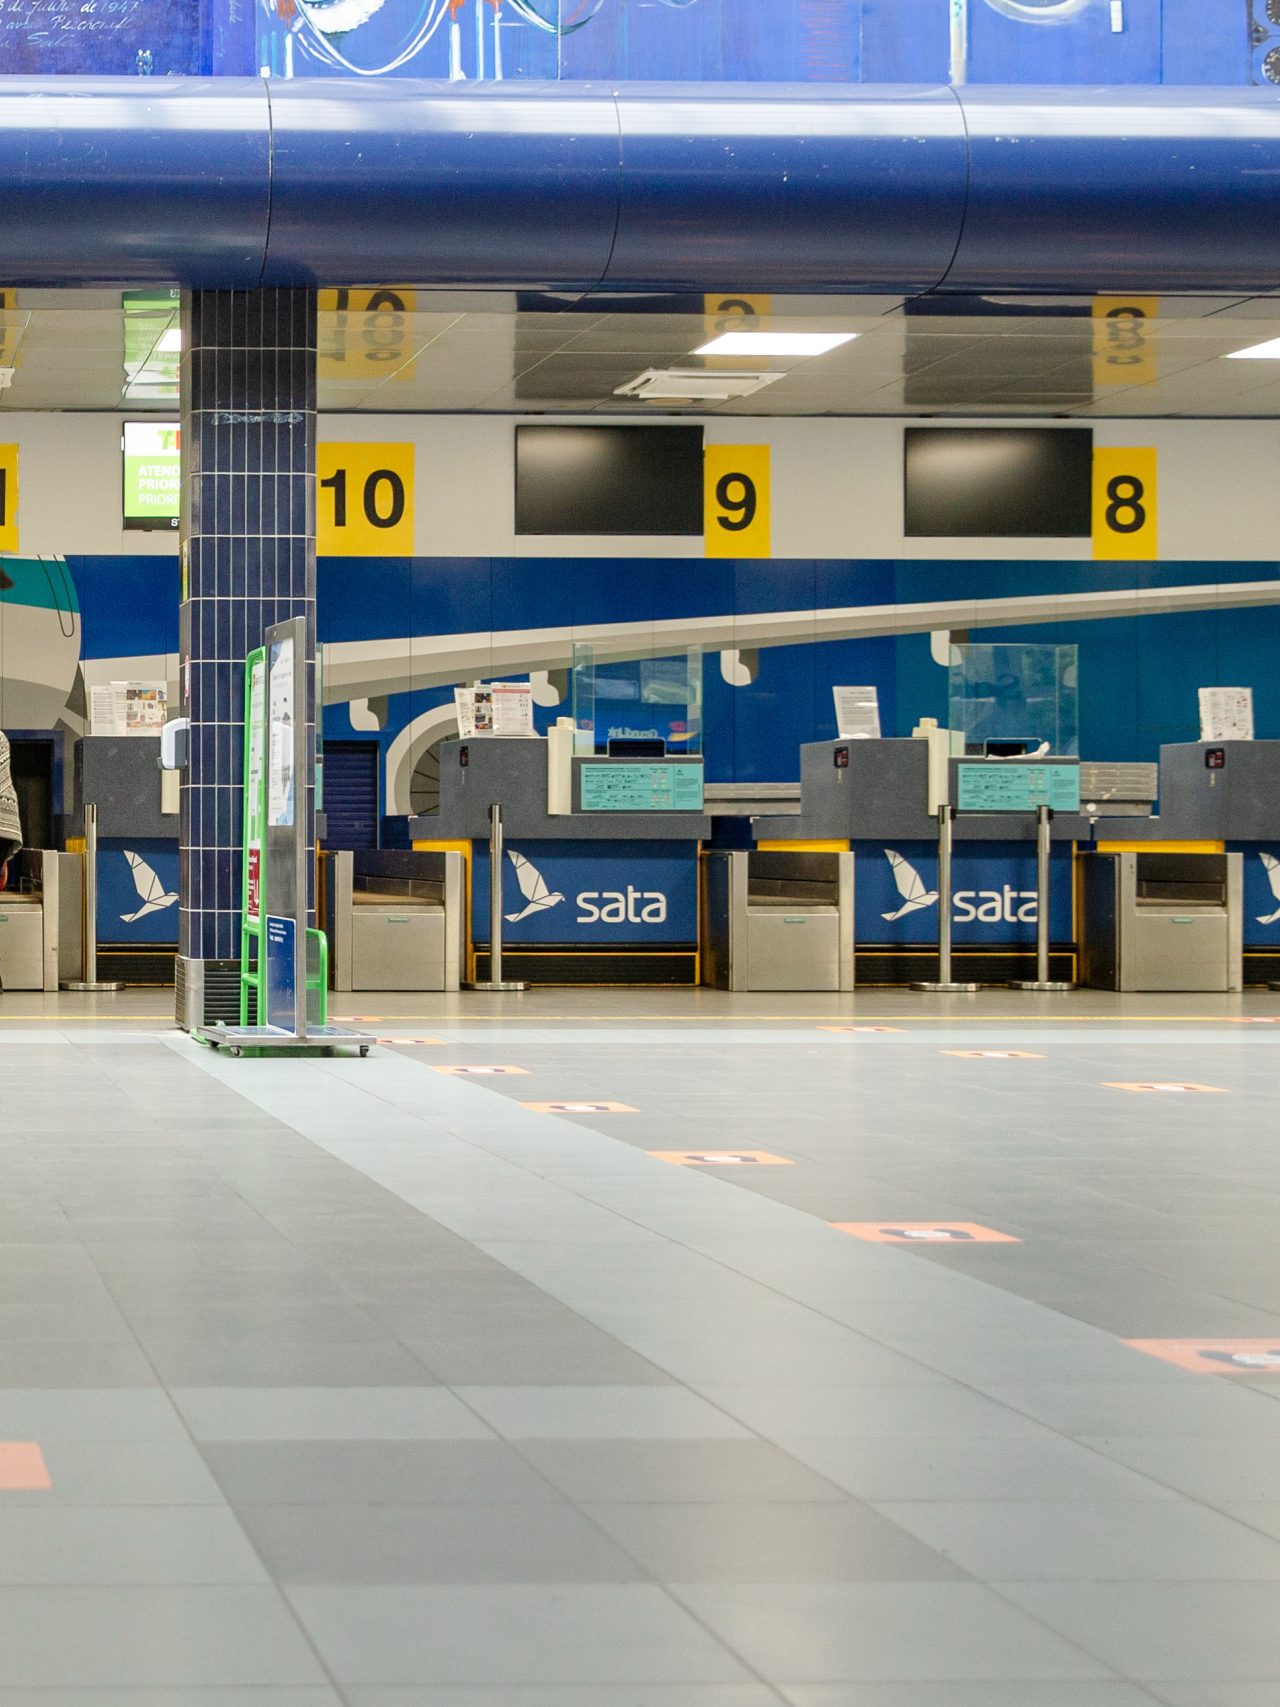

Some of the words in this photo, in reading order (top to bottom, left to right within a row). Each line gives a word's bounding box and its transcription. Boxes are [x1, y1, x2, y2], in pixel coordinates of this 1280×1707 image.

[320, 469, 406, 529] 10
[716, 472, 757, 532] 9
[1105, 475, 1146, 534] 8
[576, 885, 667, 923] sata
